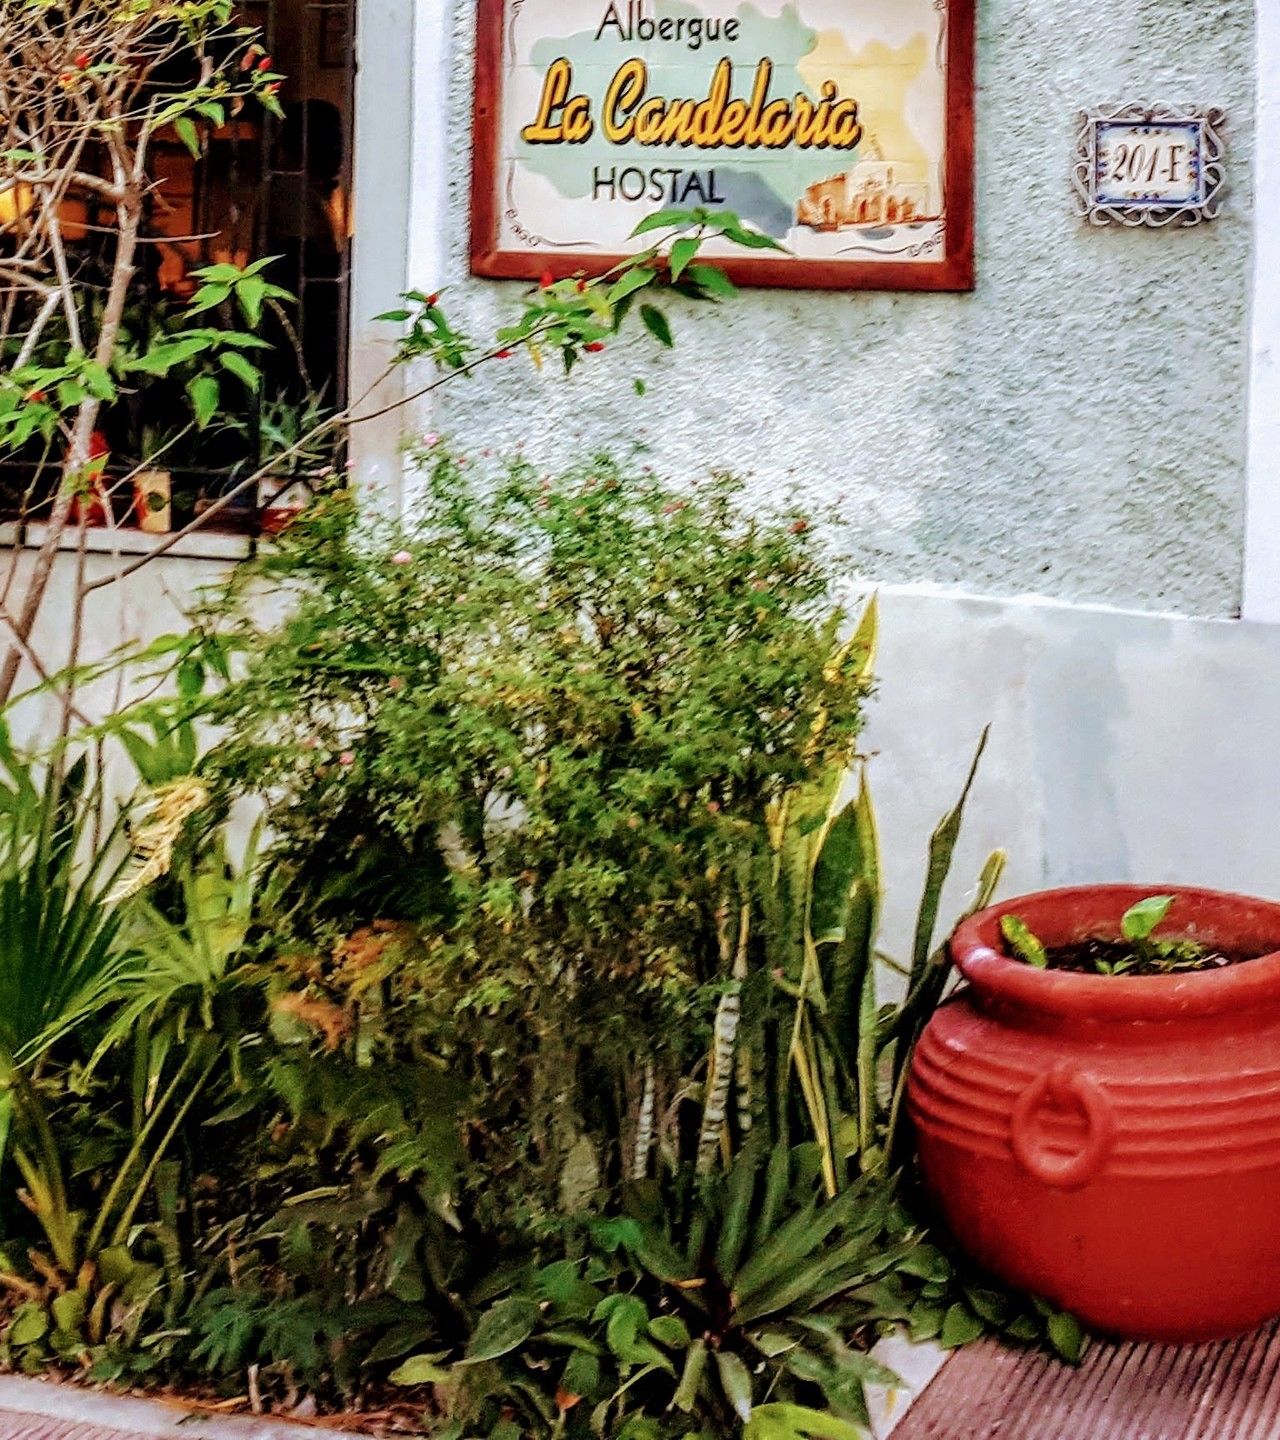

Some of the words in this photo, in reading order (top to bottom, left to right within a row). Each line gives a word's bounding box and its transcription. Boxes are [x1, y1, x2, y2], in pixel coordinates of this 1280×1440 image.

[520, 56, 593, 147] La
[602, 57, 863, 152] Candelaria
[592, 165, 725, 206] HOSTAL
